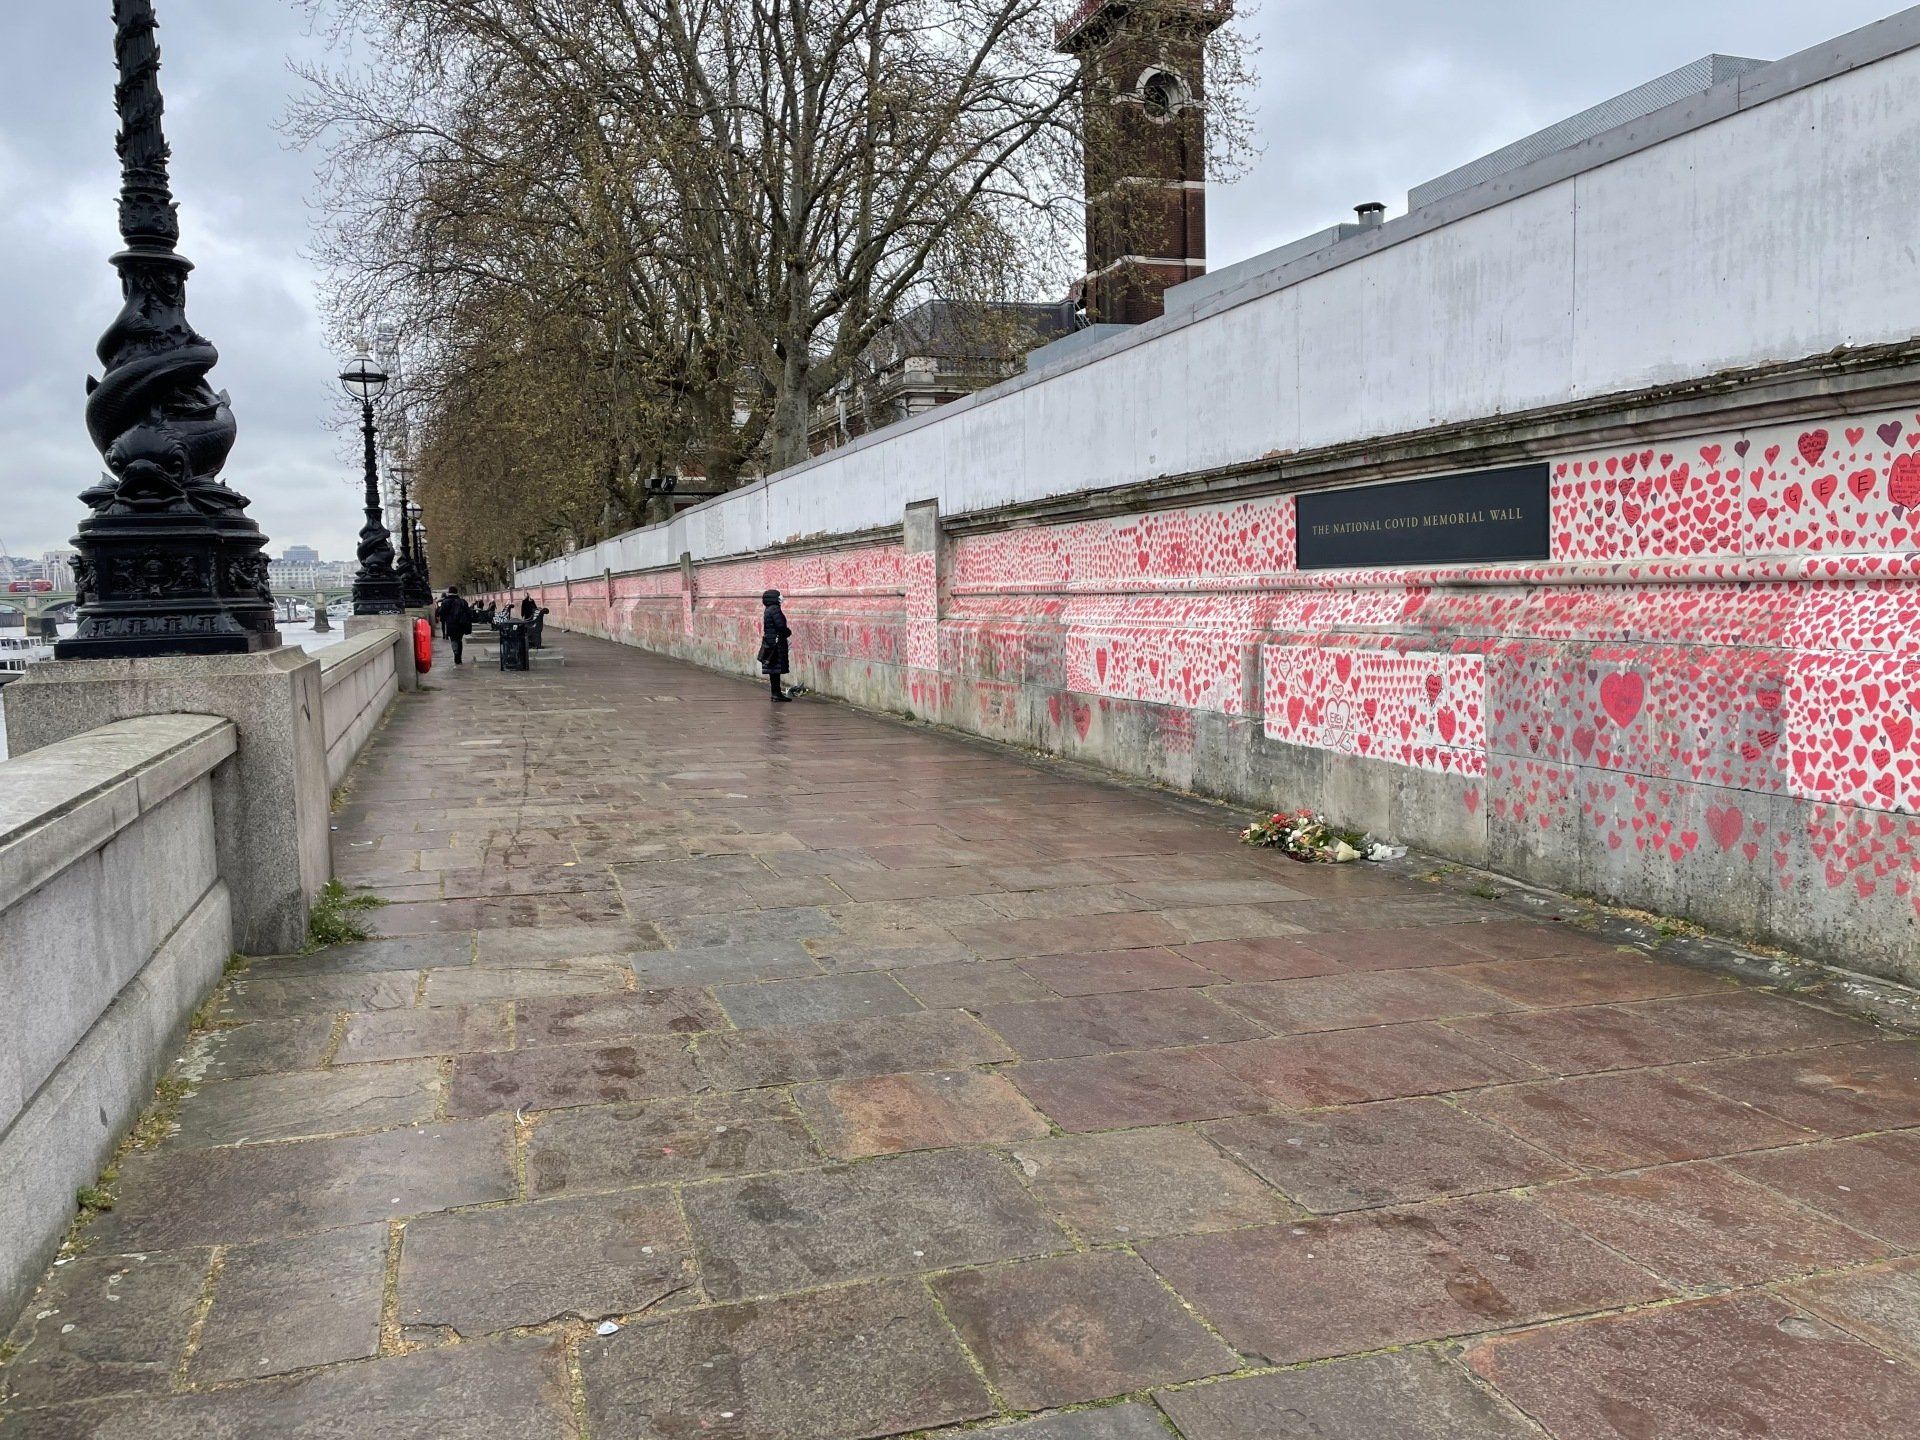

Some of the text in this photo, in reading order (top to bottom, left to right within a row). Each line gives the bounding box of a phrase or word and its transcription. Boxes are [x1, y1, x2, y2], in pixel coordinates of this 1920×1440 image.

[1788, 474, 1870, 504] G E E
[1312, 507, 1524, 536] THE NATIONAL COVID MEMORIAL WALL
